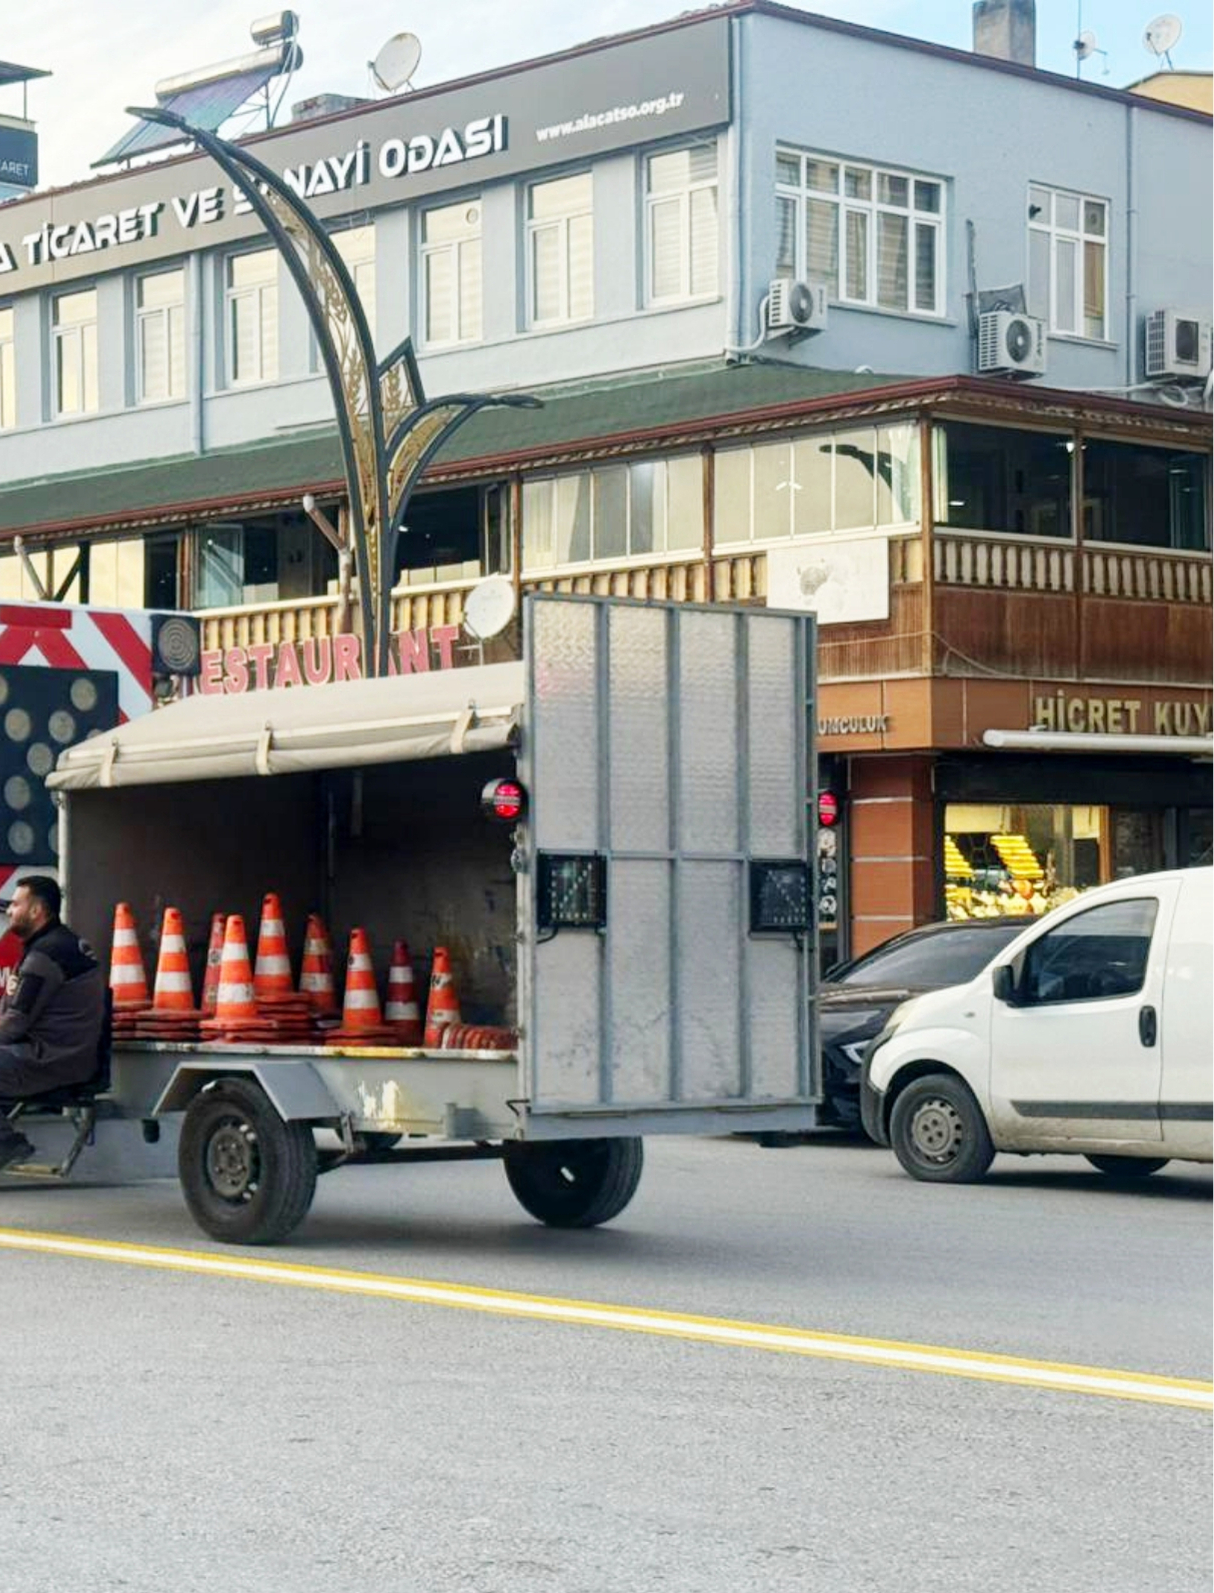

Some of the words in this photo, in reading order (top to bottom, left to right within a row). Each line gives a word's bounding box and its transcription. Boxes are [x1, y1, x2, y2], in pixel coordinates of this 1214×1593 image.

[536, 93, 683, 142] www.alacatso.org.tr
[22, 202, 160, 264] TİCARET
[170, 187, 220, 228] VE
[233, 139, 368, 216] SNAYİ
[379, 113, 503, 178] ODASI
[1036, 688, 1141, 734] HİCRET
